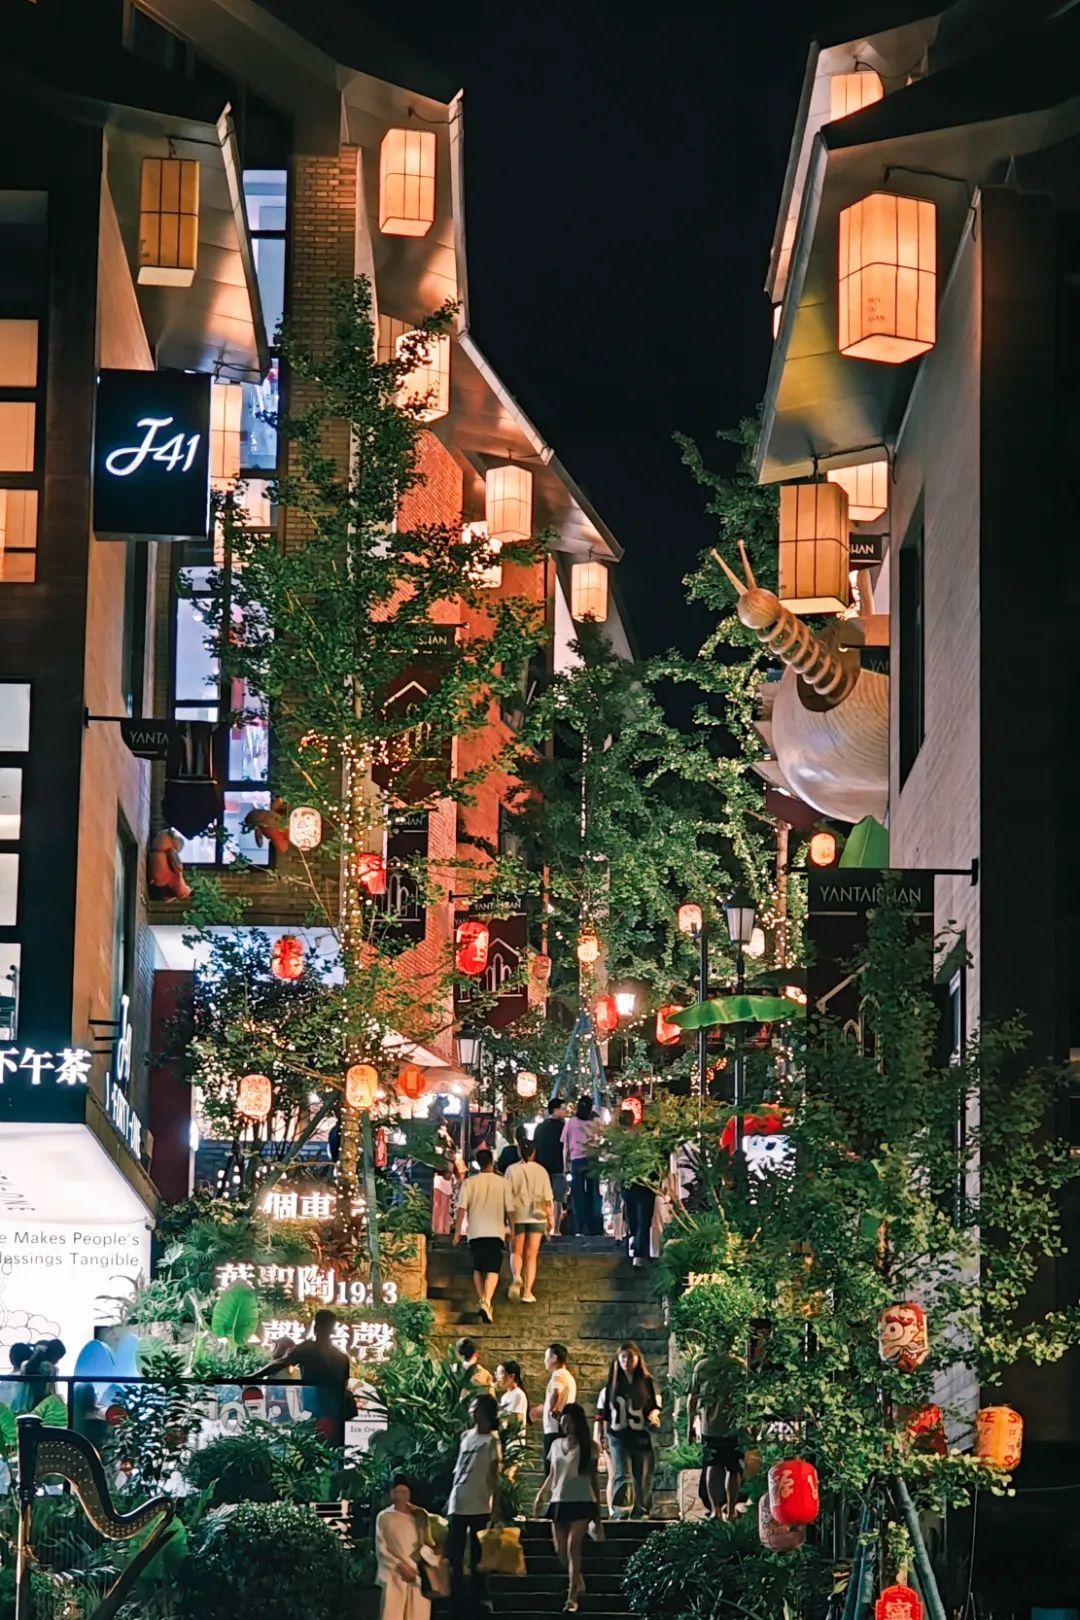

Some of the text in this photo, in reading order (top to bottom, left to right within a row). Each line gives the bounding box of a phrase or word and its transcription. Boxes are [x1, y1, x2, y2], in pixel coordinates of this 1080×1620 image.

[105, 416, 201, 476] J41
[0, 1047, 93, 1086] 下午茶
[14, 1231, 66, 1245] Makes
[73, 1231, 140, 1249] People's
[70, 1252, 139, 1268] Tangible
